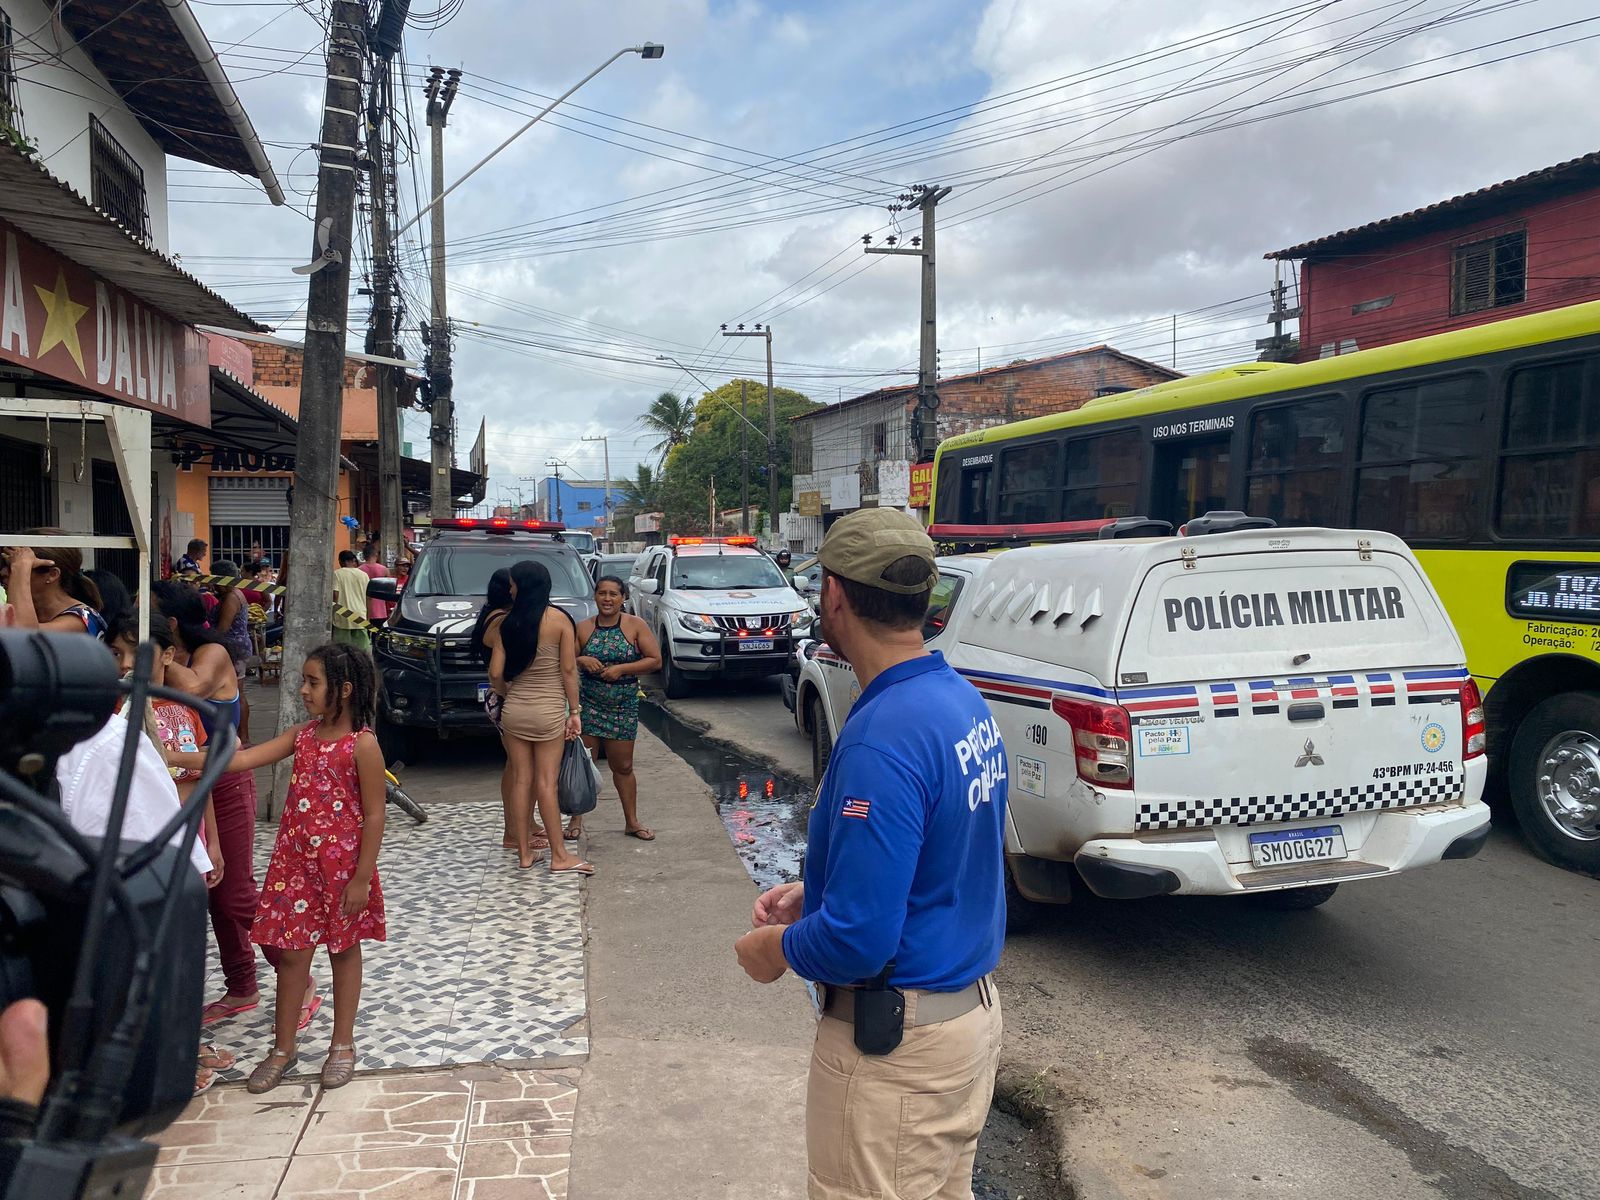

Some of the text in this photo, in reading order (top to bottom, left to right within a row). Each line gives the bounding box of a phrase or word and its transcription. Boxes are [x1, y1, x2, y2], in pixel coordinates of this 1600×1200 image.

[95, 279, 177, 411] DALVA
[1153, 415, 1235, 438] USO NOS TERMINAIS
[962, 454, 993, 467] DESEMBARQUE
[1164, 586, 1405, 633] POLÍCIA MILITAR
[1527, 622, 1588, 638] Fabricação:
[1523, 634, 1575, 650] Operação:
[1032, 724, 1047, 746] 190
[1148, 736, 1165, 744] pela
[1020, 759, 1032, 769] Pacto
[1413, 760, 1454, 776] VP-24-456
[1032, 771, 1041, 781] Paz
